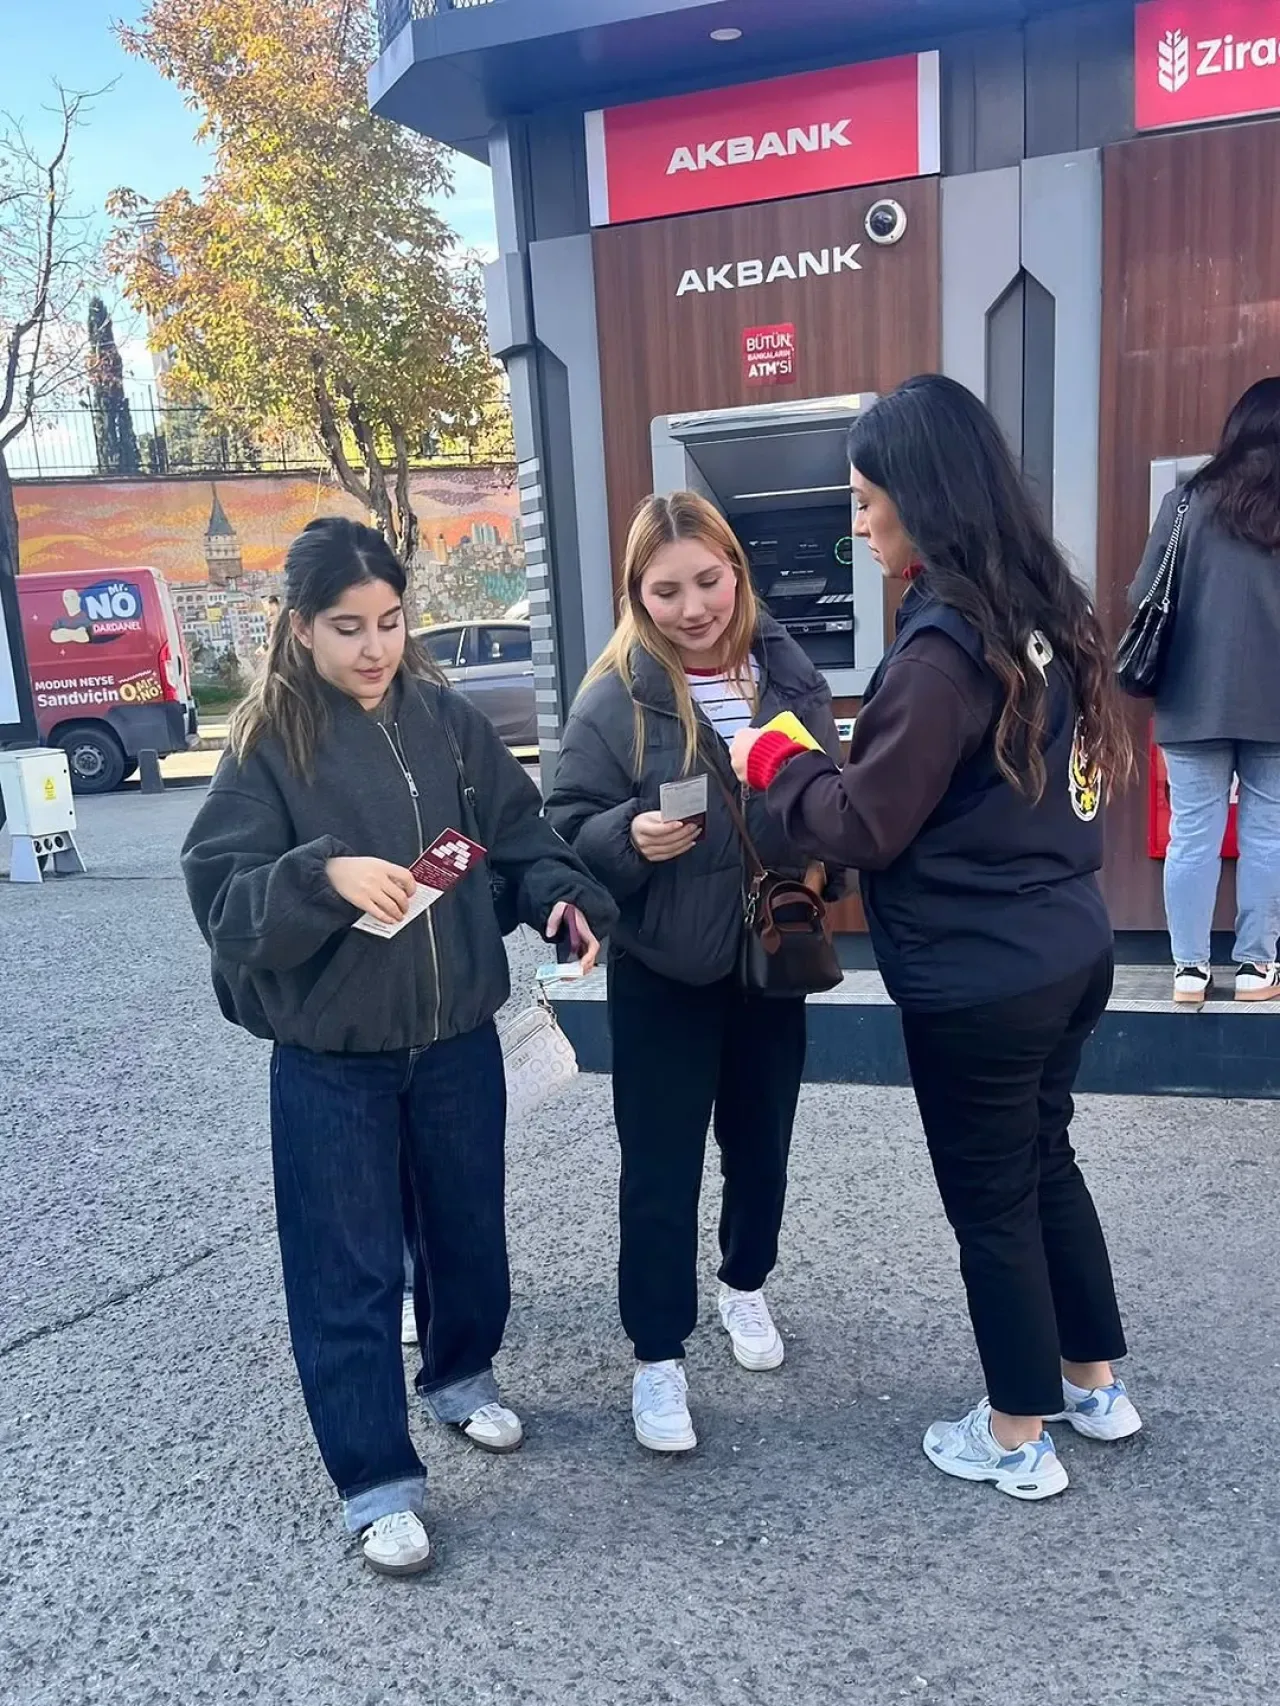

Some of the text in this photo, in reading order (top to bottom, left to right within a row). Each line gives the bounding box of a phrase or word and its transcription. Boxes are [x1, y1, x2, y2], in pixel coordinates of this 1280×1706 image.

[1195, 33, 1280, 76] Zira
[665, 118, 853, 175] AKBANK
[675, 242, 863, 297] AKBANK
[746, 332, 791, 352] BÜTÜN
[108, 583, 128, 595] Mr.
[85, 592, 136, 619] NO
[93, 621, 142, 632] DARDANEL
[35, 679, 77, 691] MODUN
[80, 675, 114, 687] NEYSE
[37, 687, 119, 708] Sandviçin
